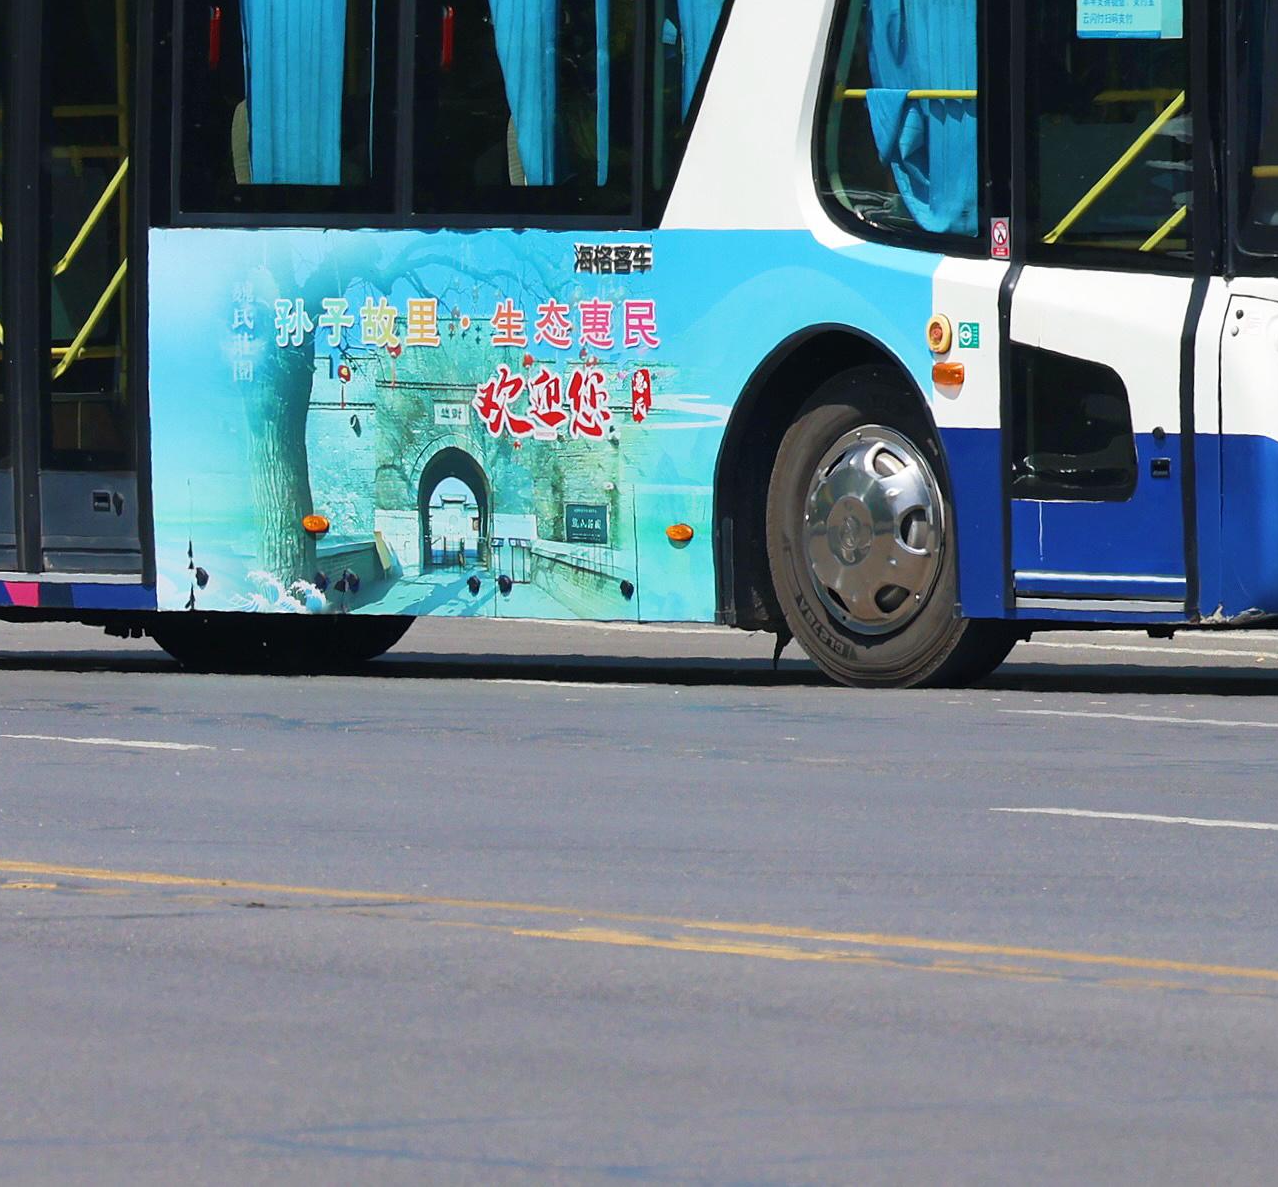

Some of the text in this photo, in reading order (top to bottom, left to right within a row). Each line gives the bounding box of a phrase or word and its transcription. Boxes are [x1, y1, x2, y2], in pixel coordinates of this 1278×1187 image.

[573, 245, 653, 274] 海格客车
[477, 367, 612, 438] 欢迎您
